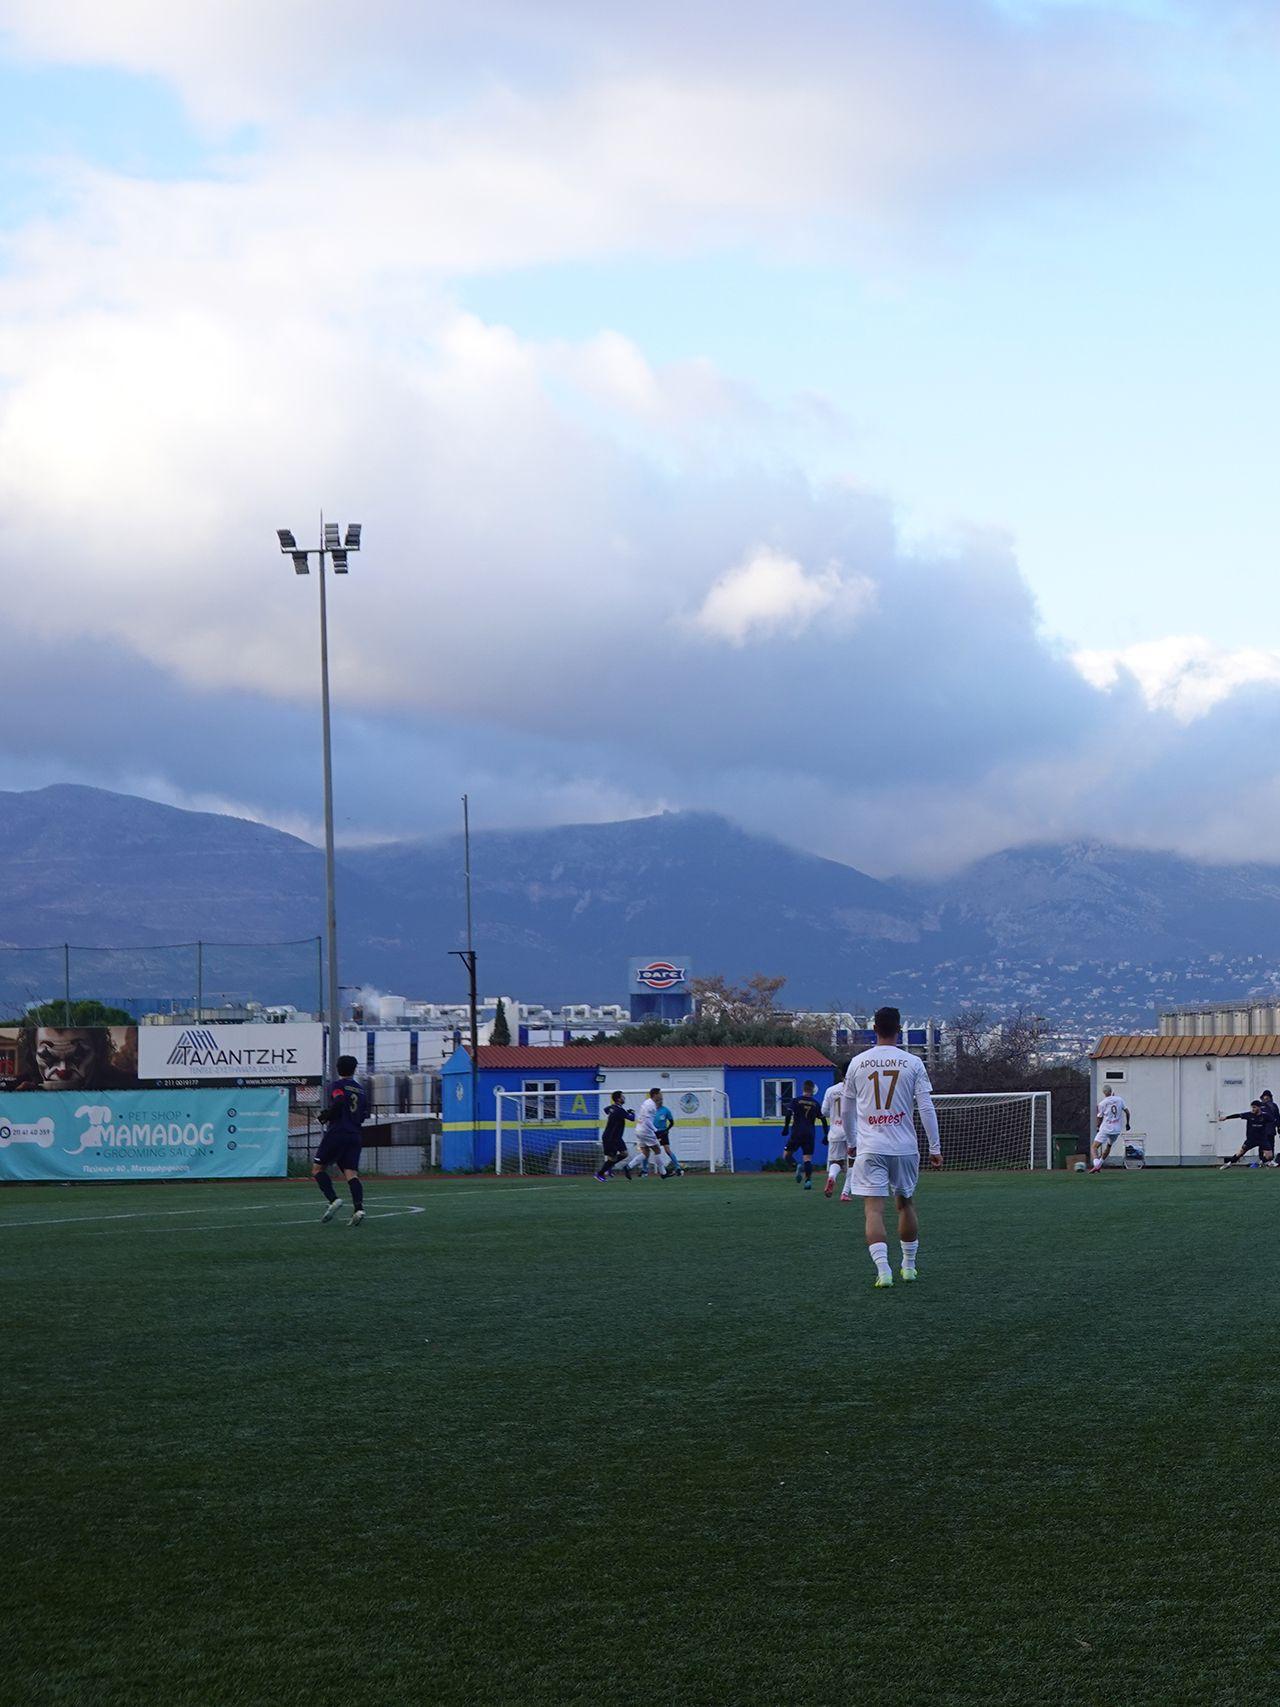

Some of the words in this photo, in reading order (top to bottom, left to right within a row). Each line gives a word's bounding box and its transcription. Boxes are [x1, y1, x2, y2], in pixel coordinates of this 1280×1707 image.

[177, 1045, 298, 1066] ΤΑΛΑΝΤΖΗΣ
[860, 1059, 897, 1069] APOLLON
[897, 1059, 908, 1068] FC
[867, 1070, 900, 1110] 17
[349, 1093, 359, 1113] 3
[128, 1111, 147, 1121] PET
[151, 1110, 182, 1121] SHOP
[803, 1105, 812, 1119] 7
[1110, 1104, 1118, 1118] 9
[868, 1111, 906, 1126] everest
[98, 1122, 214, 1147] MAMADOG
[103, 1148, 166, 1159] GROOMING
[169, 1147, 207, 1157] SALON
